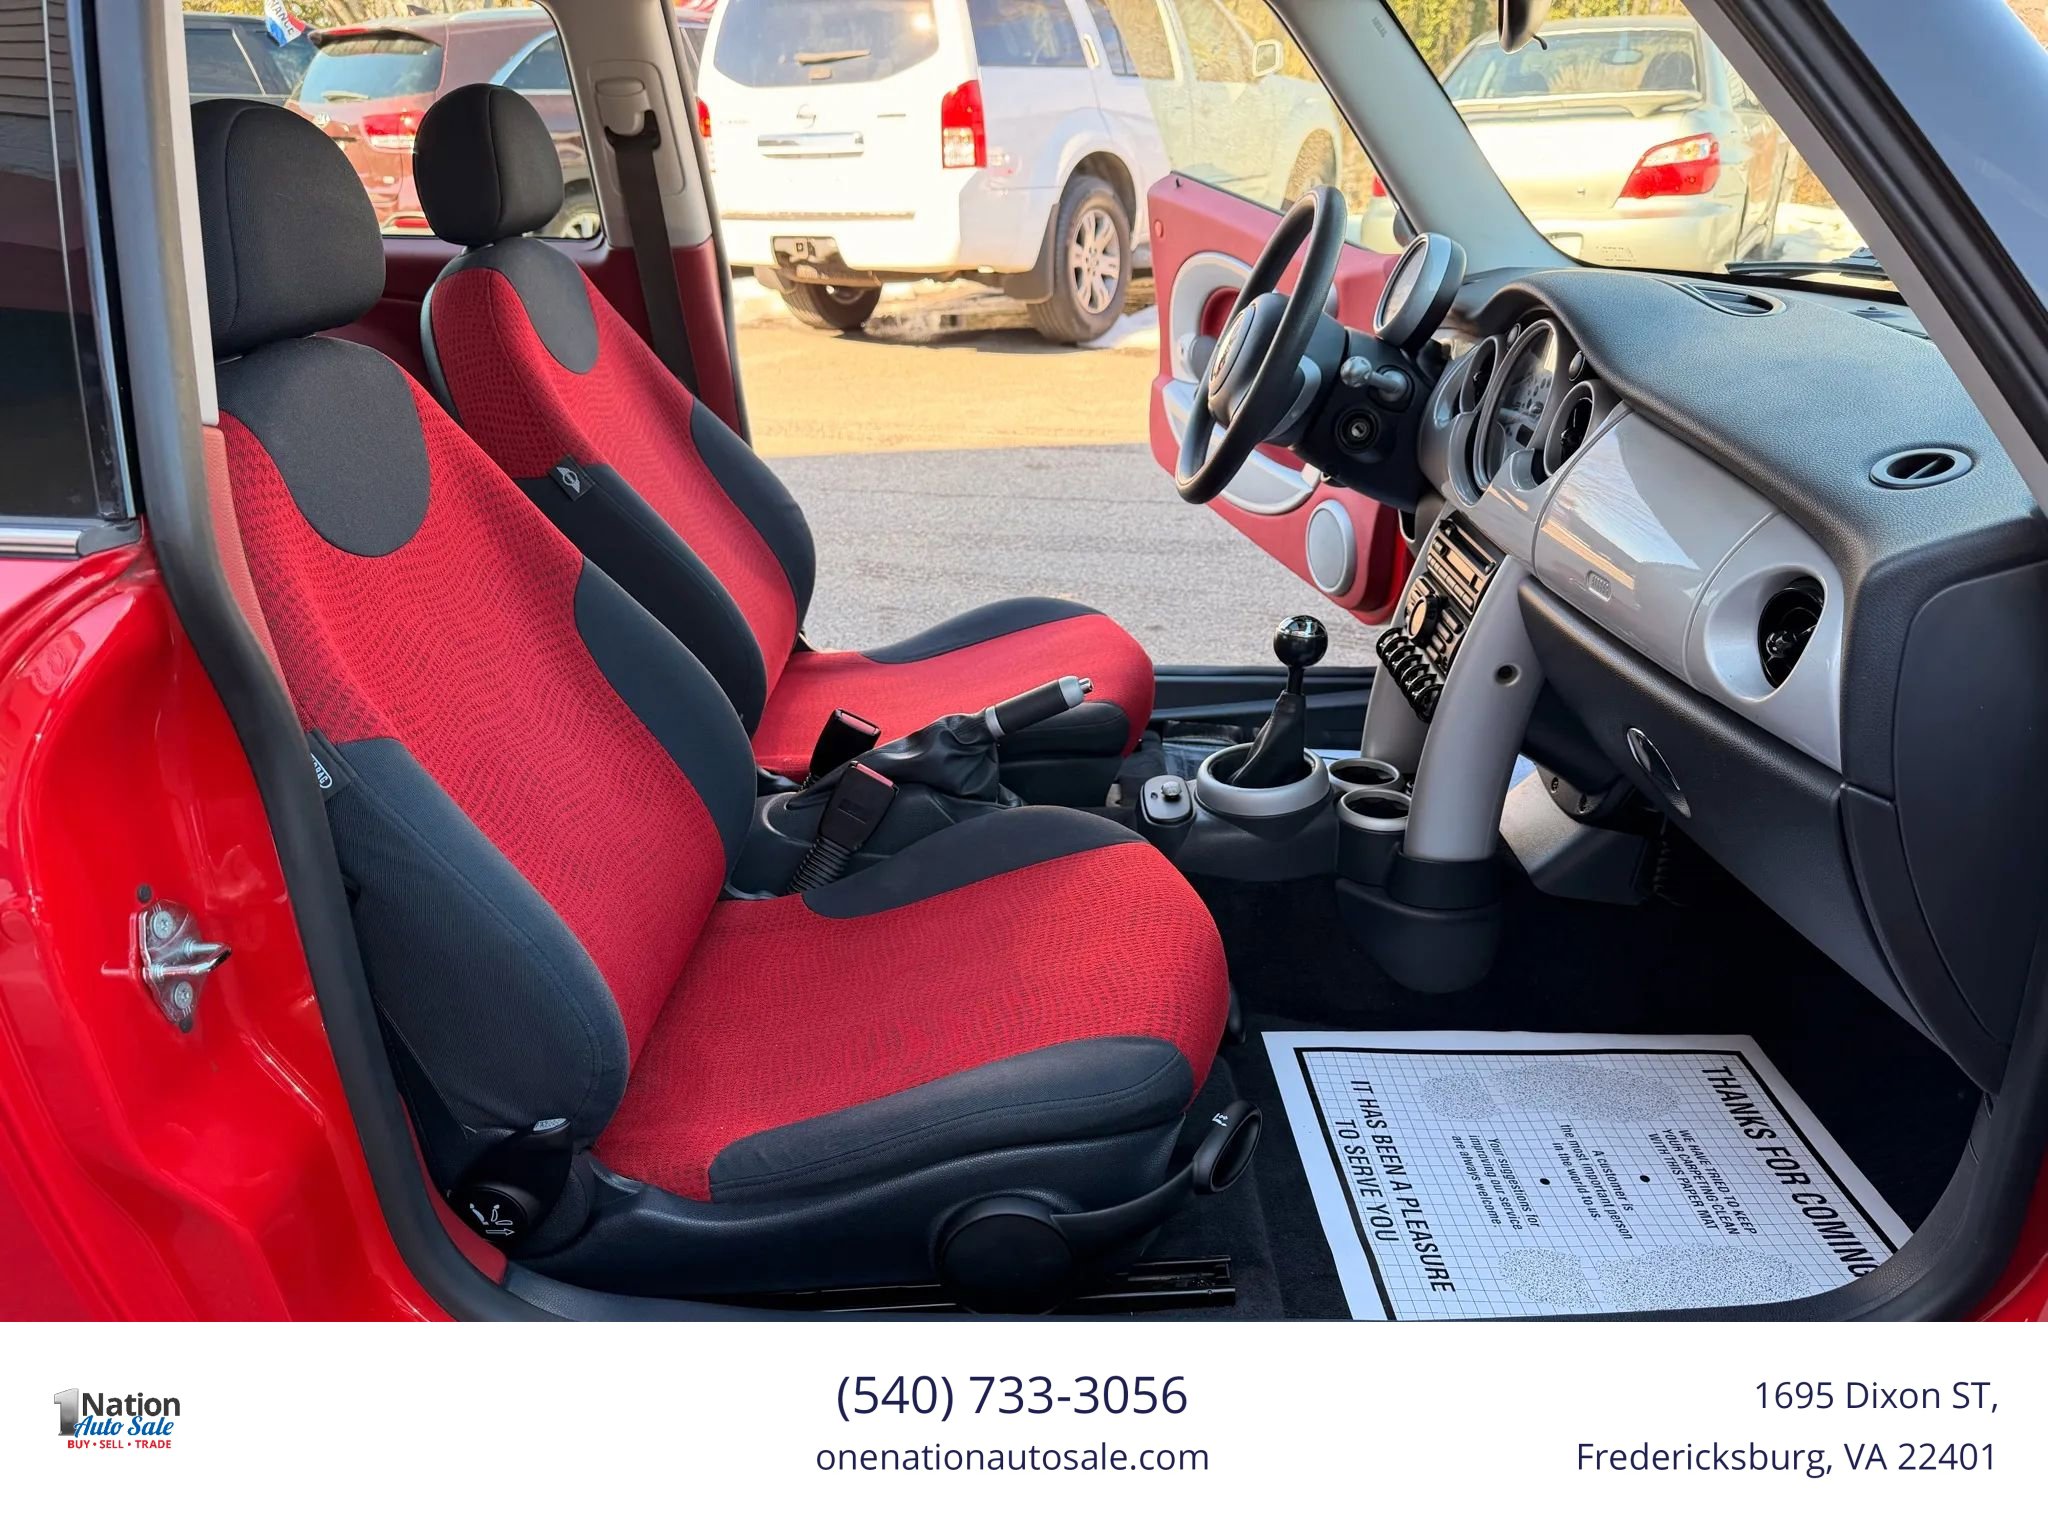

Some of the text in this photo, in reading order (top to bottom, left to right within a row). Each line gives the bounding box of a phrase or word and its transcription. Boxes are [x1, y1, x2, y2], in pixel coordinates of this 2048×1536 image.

[1452, 1135, 1466, 1150] are
[1459, 1151, 1481, 1181] always
[1552, 1142, 1564, 1151] in
[1558, 1153, 1572, 1167] the
[1567, 1168, 1590, 1194] world
[1581, 1195, 1594, 1206] to
[1702, 1066, 1777, 1139] THANKS
[1755, 1146, 1811, 1185] FOR
[1335, 1119, 1399, 1242] TO SERVE YOU
[1350, 1080, 1456, 1293] IT HAS BEEN A PLEASURE
[1469, 1135, 1523, 1230] improving our service
[1487, 1138, 1540, 1227] Your suggestions for
[1560, 1124, 1633, 1240] the most important person
[1597, 1158, 1628, 1201] customer
[1621, 1203, 1634, 1212] is
[1648, 1133, 1720, 1230] WITH THIS PAPER MAT
[1662, 1129, 1741, 1235] YOUR CARPETING CLEAN
[1679, 1129, 1757, 1235] WE HAVE TRIED TO KEEP
